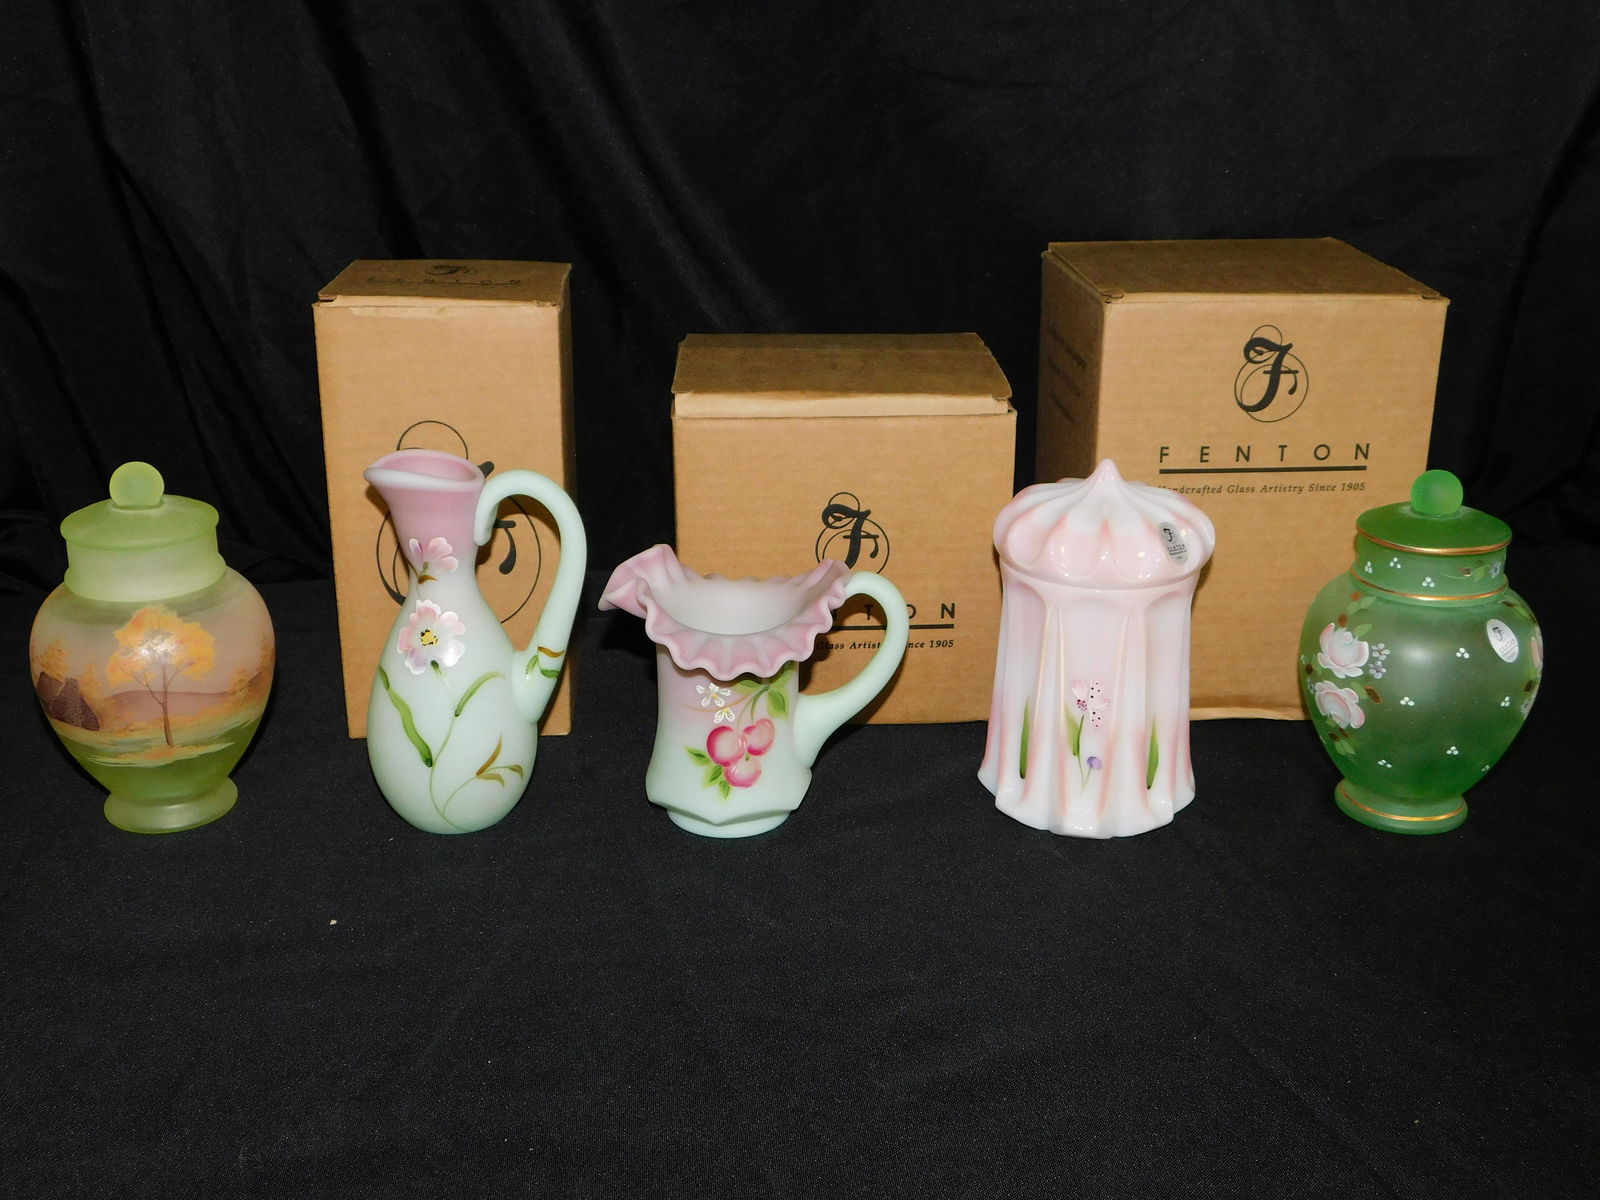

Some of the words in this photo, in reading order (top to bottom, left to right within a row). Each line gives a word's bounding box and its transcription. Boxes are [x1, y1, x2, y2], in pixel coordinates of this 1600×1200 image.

[1159, 443, 1370, 464] FENTON
[1158, 485, 1223, 497] dcrafted
[1226, 484, 1256, 494] Glass
[1260, 484, 1304, 495] Artistry
[1308, 483, 1337, 493] Since
[1340, 482, 1366, 492] 1905
[849, 640, 881, 650] Artist
[929, 639, 954, 649] 1905
